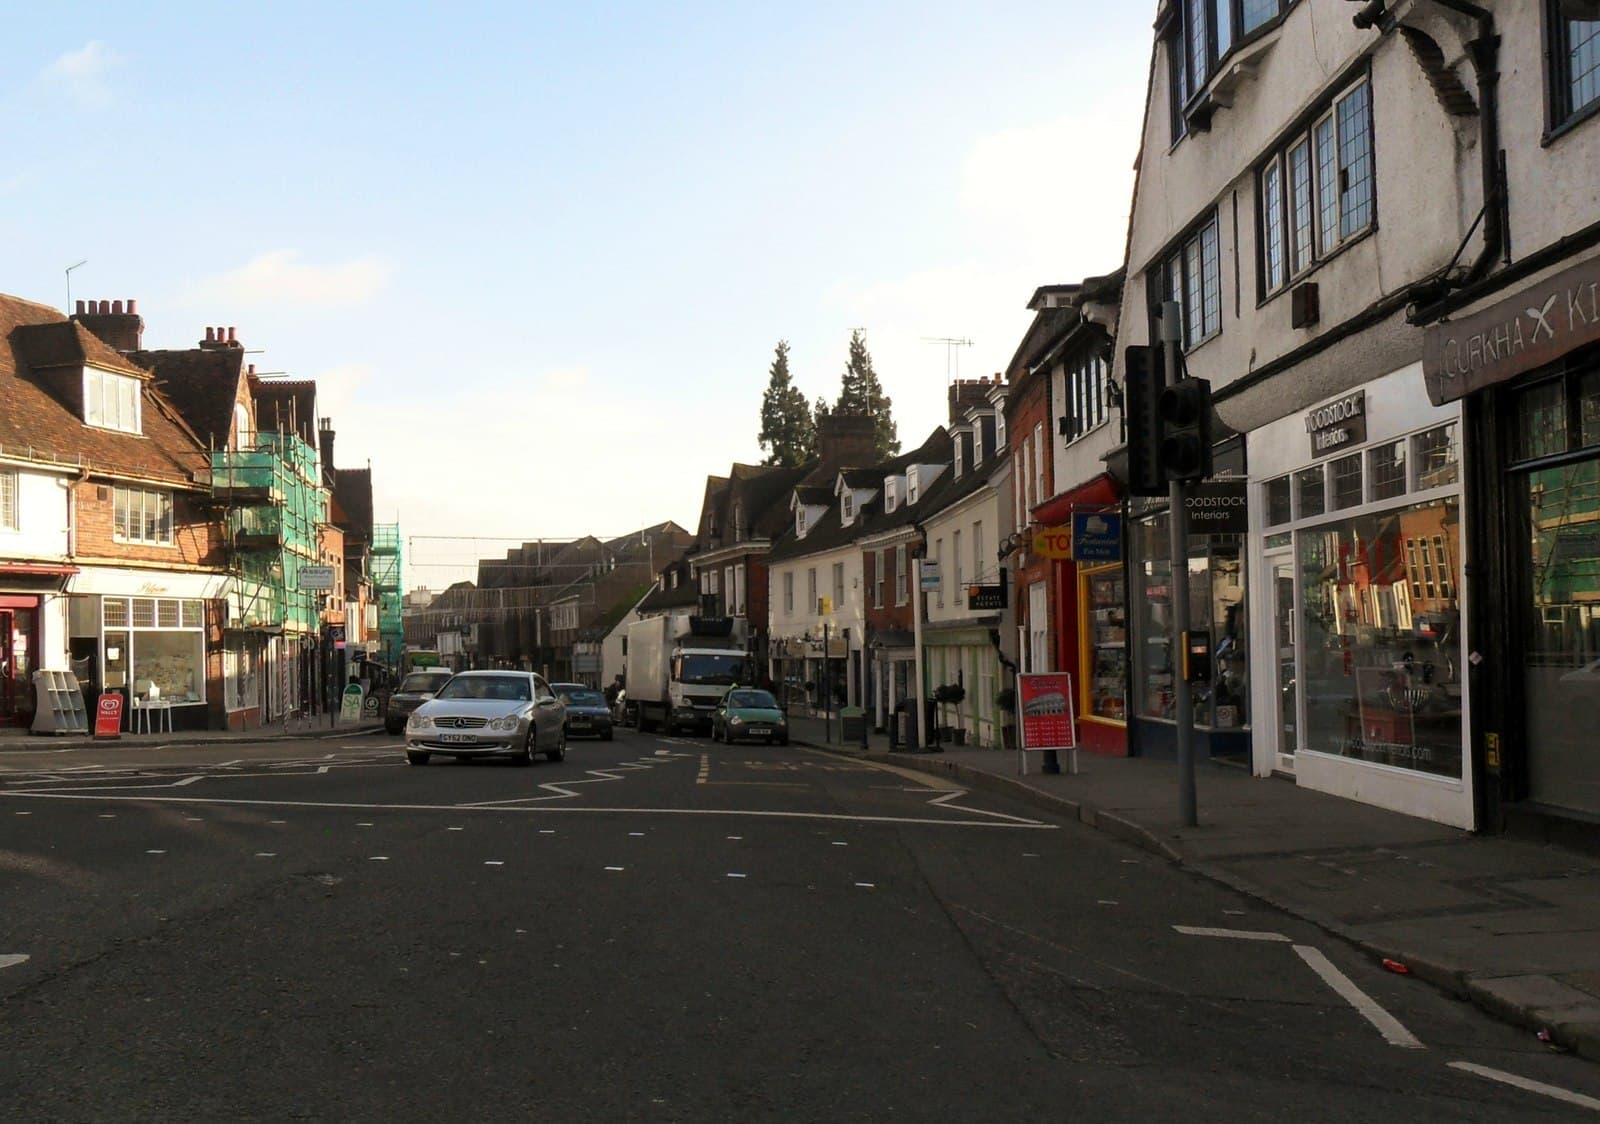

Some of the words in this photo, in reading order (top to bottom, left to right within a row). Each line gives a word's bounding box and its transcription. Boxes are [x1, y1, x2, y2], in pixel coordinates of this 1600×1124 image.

[1443, 317, 1525, 379] GURKHA
[1304, 395, 1362, 434] WOODSTOCK
[1184, 496, 1246, 508] OODSTOCK
[1191, 510, 1231, 521] Interiors
[1043, 534, 1072, 552] TO
